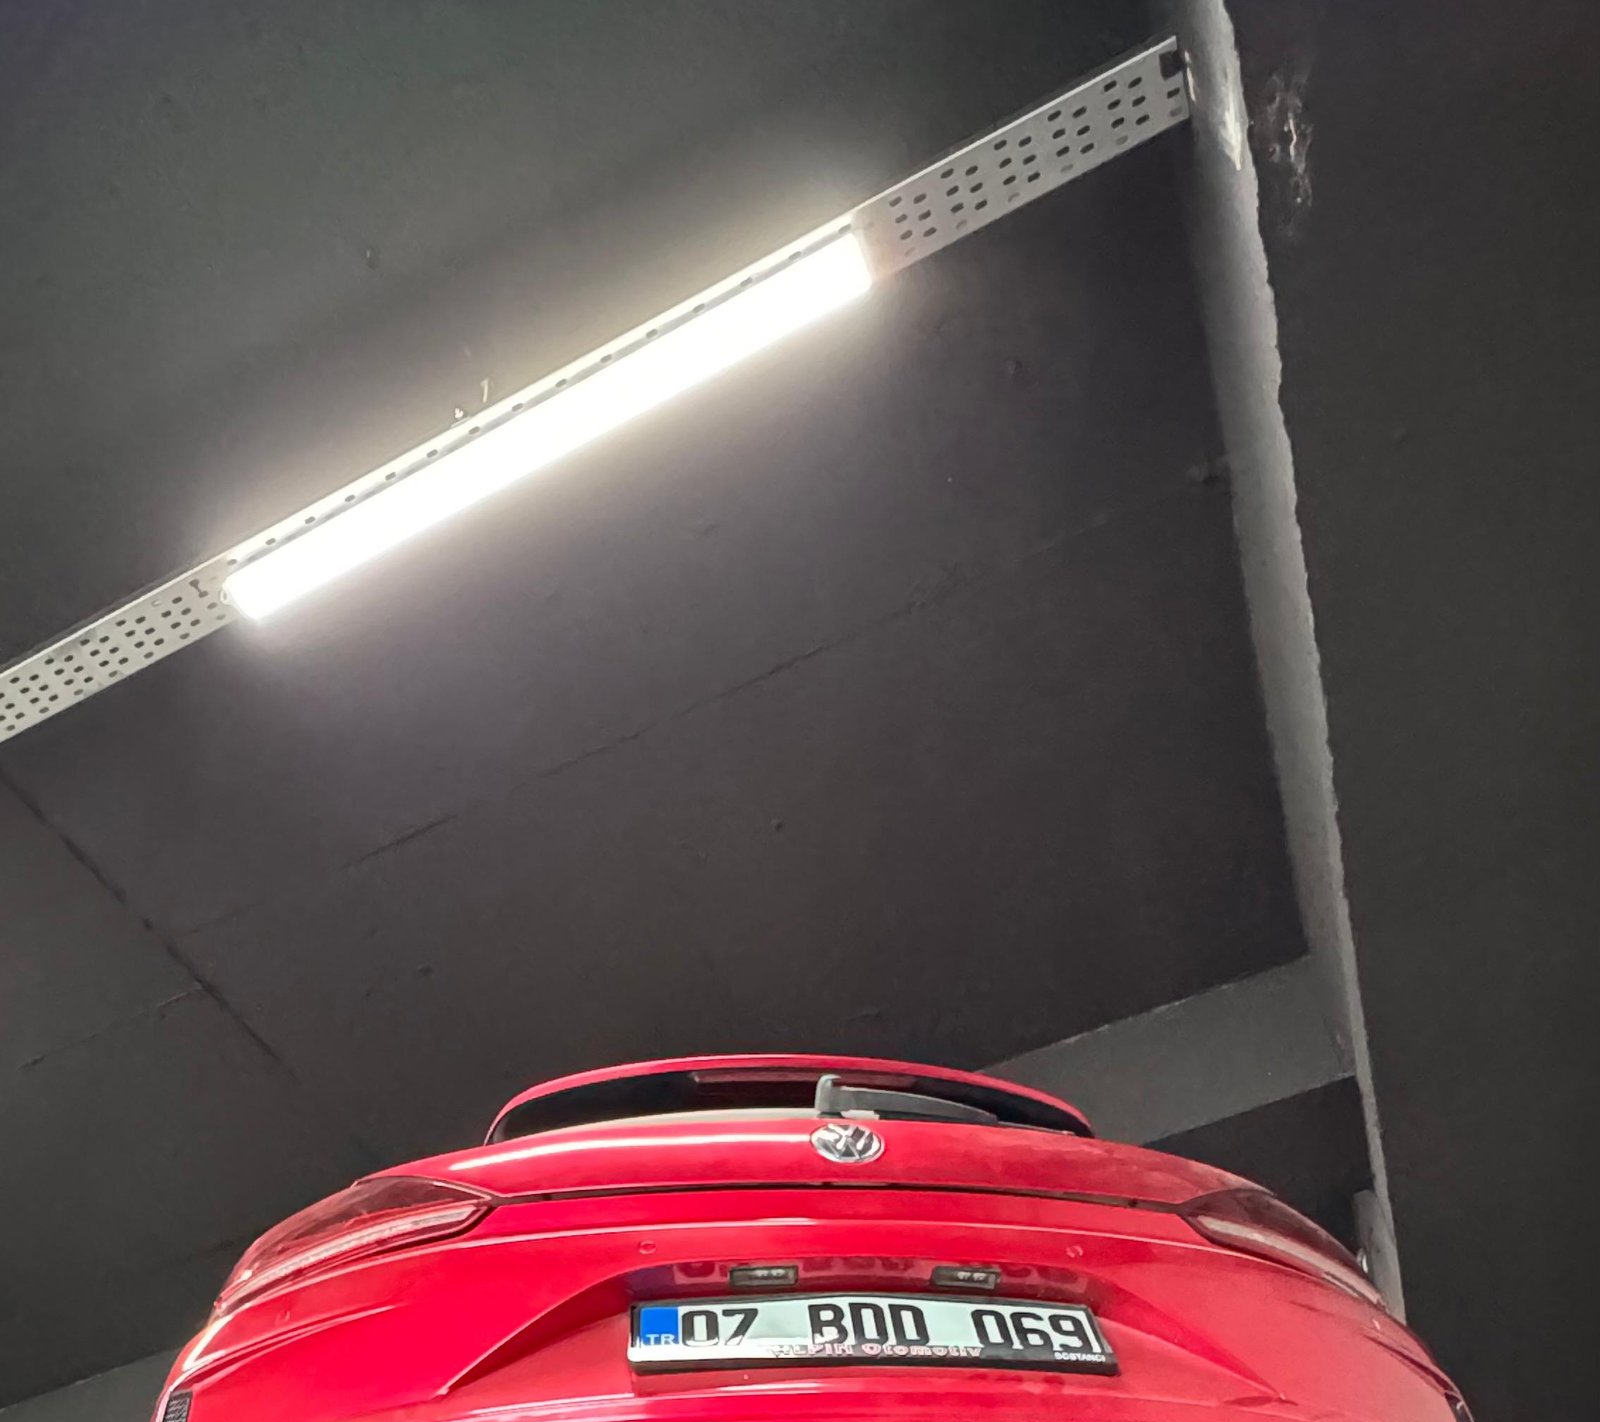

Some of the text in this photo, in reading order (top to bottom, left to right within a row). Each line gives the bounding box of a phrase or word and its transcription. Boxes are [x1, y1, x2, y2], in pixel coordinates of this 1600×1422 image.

[647, 1334, 677, 1346] TR
[681, 1303, 1092, 1353] 07 BDD 069
